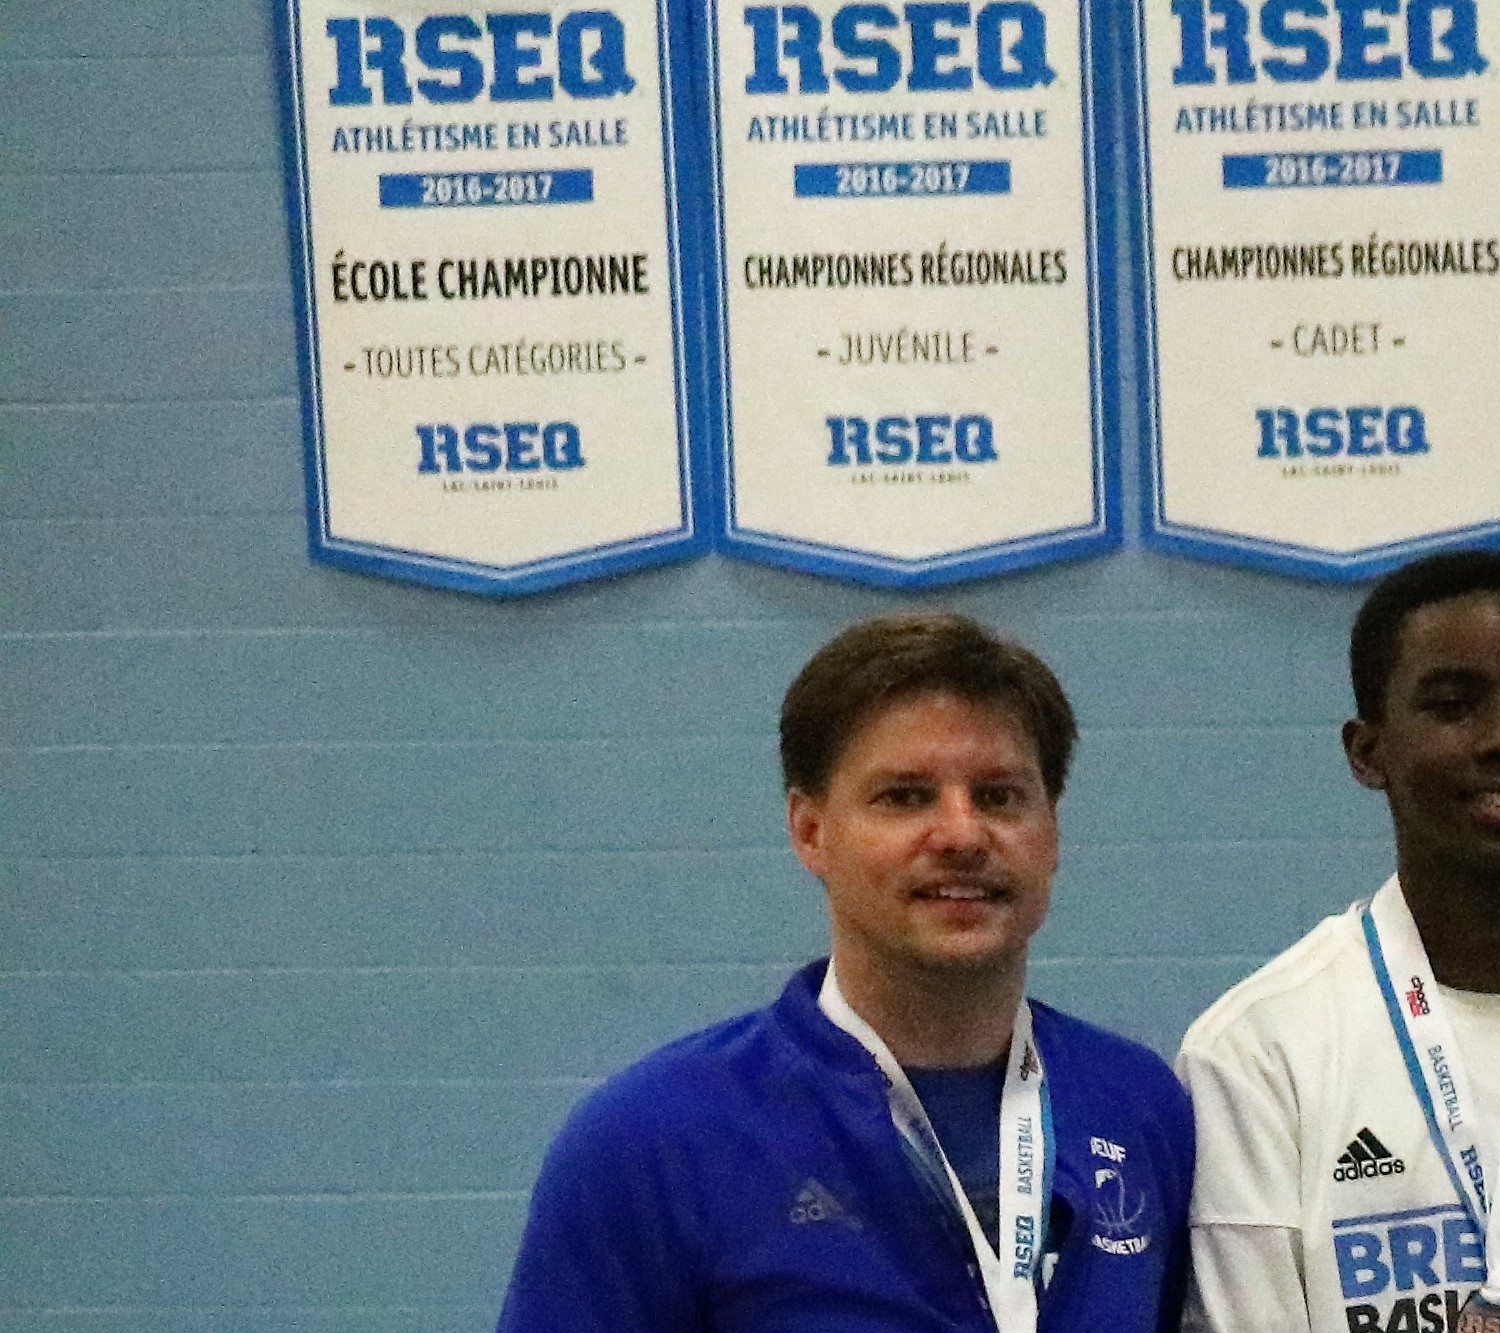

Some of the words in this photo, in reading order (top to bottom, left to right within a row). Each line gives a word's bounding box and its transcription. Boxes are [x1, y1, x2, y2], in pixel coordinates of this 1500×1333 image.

[326, 11, 635, 105] RSEQ
[744, 0, 1056, 93] RSEQ
[1171, 0, 1489, 84] RSEQ
[332, 121, 499, 152] ATHLÉTISME
[506, 124, 542, 148] EN
[548, 119, 627, 148] SALLE
[748, 110, 914, 141] ATHLÉTISME
[923, 114, 959, 139] EN
[966, 110, 1046, 138] SALLE
[1175, 99, 1344, 132] ATHLÉTISME
[1352, 103, 1390, 128] EN
[1396, 100, 1479, 128] SALLE
[422, 173, 553, 203] 2016-2017
[837, 165, 969, 194] 2016-2017
[1266, 155, 1400, 184] 2016-2017
[332, 251, 427, 302] ÉCOLE
[438, 255, 650, 299] CHAMPIONNE
[744, 254, 913, 288] CHAMPIONNES
[921, 240, 1068, 285] RÉGIONALES
[1172, 244, 1344, 280] CHAMPIONNES
[1351, 233, 1500, 276] RÉGIONALES
[417, 423, 585, 473] RSEQ
[827, 416, 997, 464] RSEQ
[1256, 407, 1429, 457] RSEQ
[1427, 1044, 1464, 1131] BASKETBALL
[1333, 1157, 1405, 1182] adidas
[1014, 1216, 1034, 1280] RSEQ
